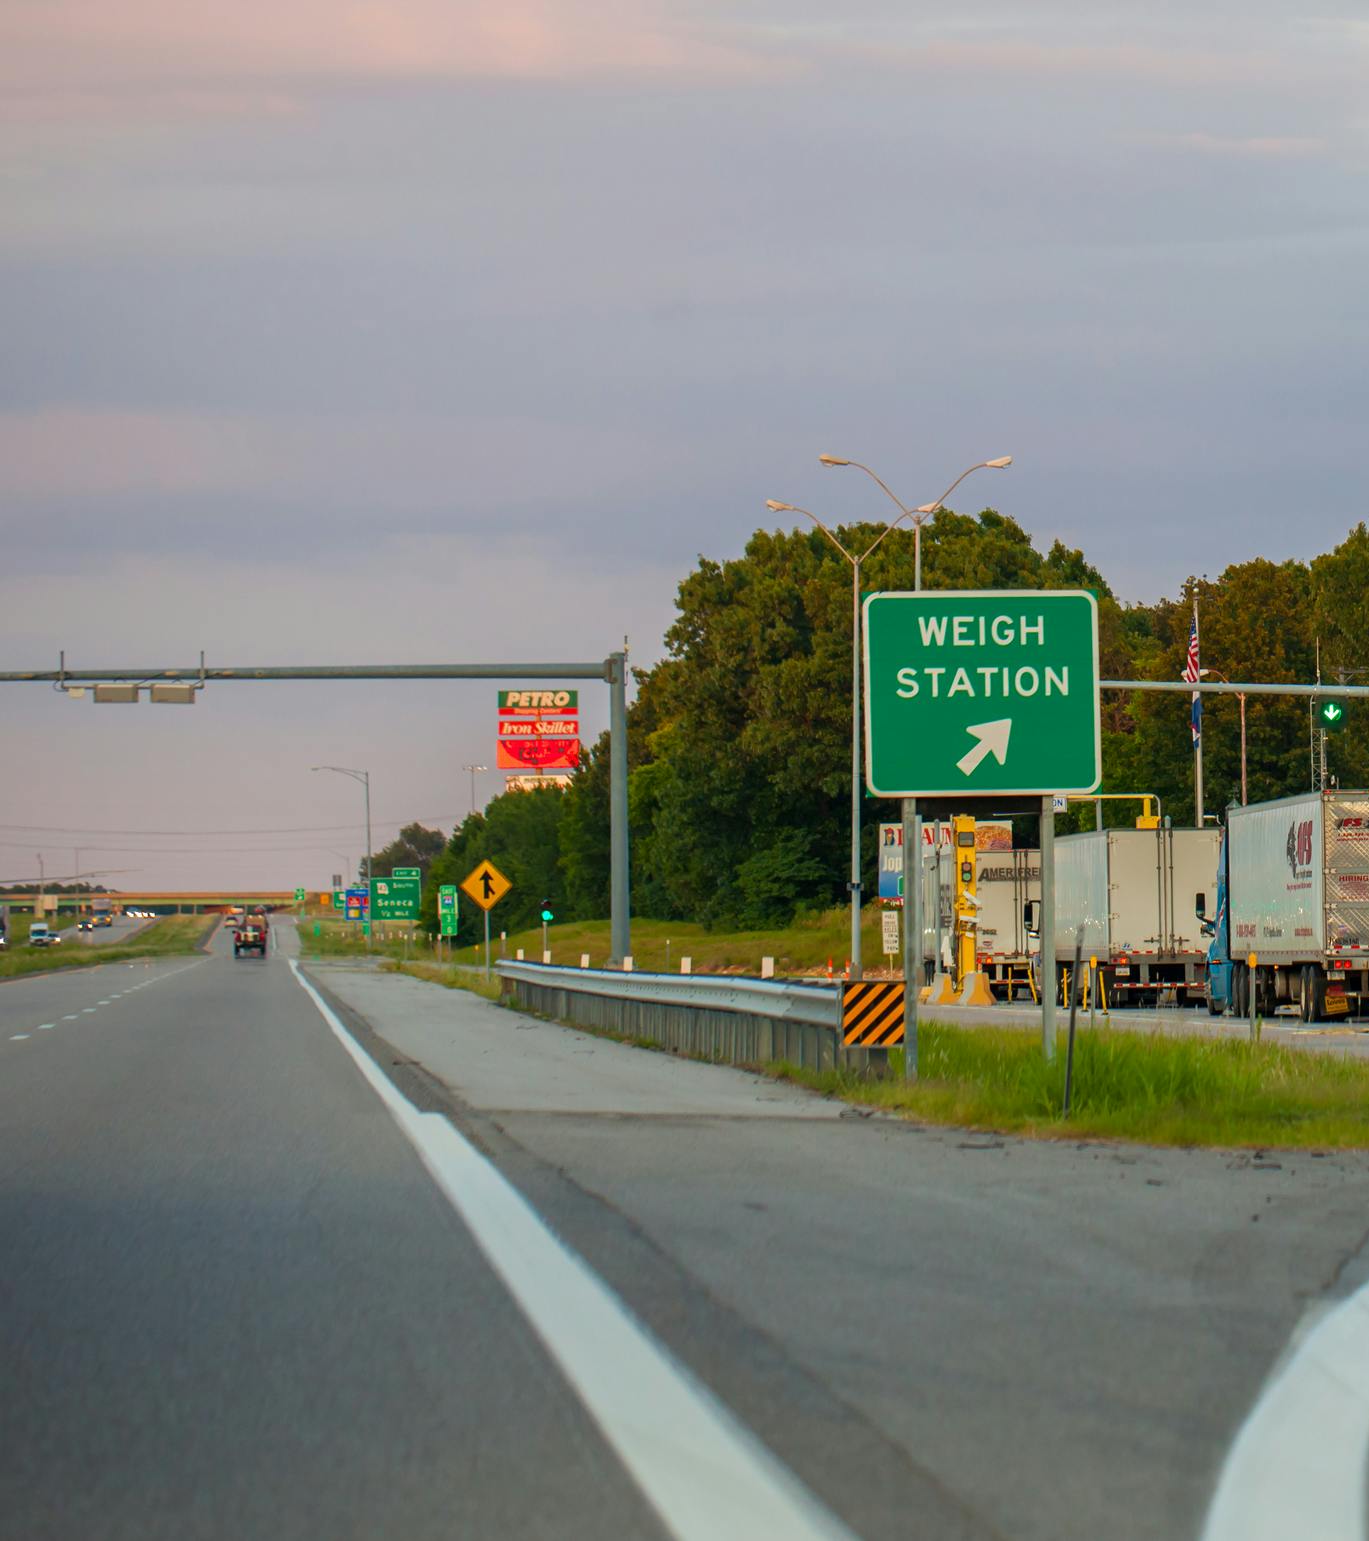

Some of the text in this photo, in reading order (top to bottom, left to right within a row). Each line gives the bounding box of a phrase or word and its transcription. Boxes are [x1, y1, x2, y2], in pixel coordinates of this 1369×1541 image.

[918, 615, 1044, 646] WEIGH
[896, 666, 1069, 698] STATION
[506, 691, 570, 707] PETRO
[502, 721, 576, 735] Iron Skillet
[377, 899, 413, 907] Seneca
